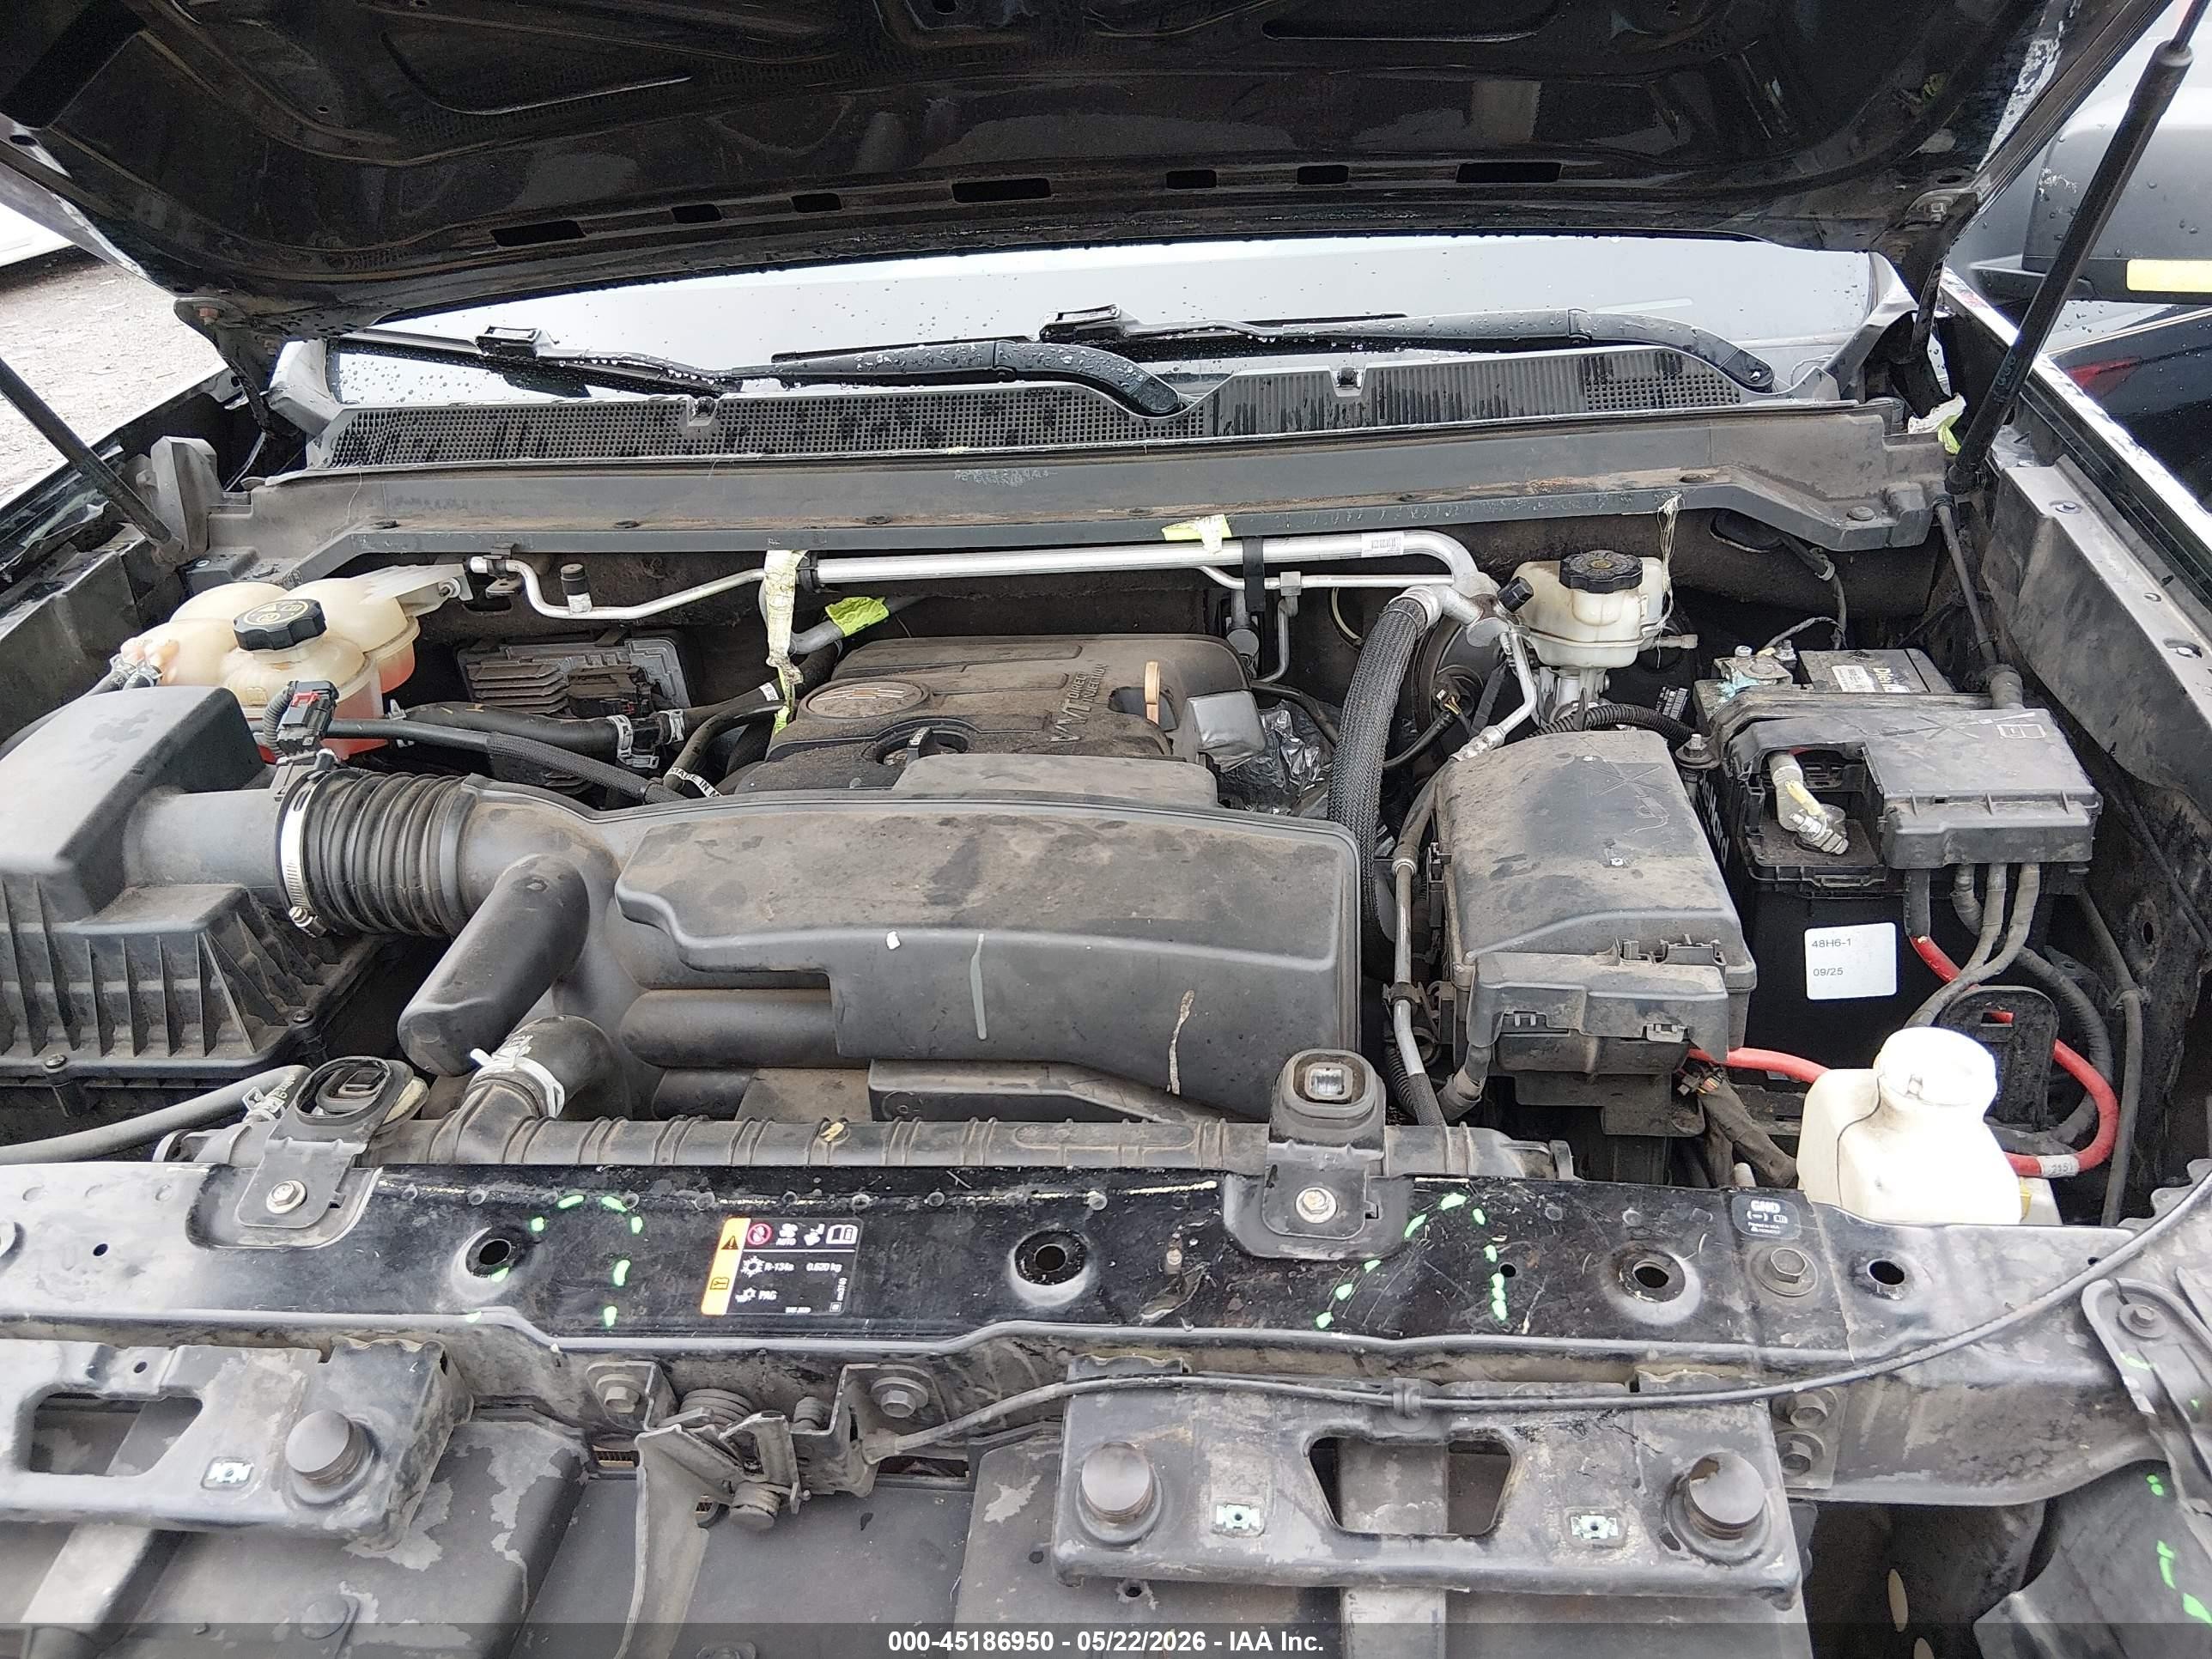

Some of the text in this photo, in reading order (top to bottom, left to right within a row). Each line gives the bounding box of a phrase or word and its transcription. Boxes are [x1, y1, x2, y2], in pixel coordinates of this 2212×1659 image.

[669, 768, 698, 781] MADE
[699, 780, 710, 792] IN
[1811, 938, 1851, 948] 48H6-1
[1813, 967, 1844, 977] 09/25
[1750, 1200, 1780, 1213] GND
[776, 1237, 796, 1246] AUTO
[764, 1262, 794, 1272] R-134a
[830, 1262, 842, 1273] kg
[758, 1291, 778, 1301] PAG
